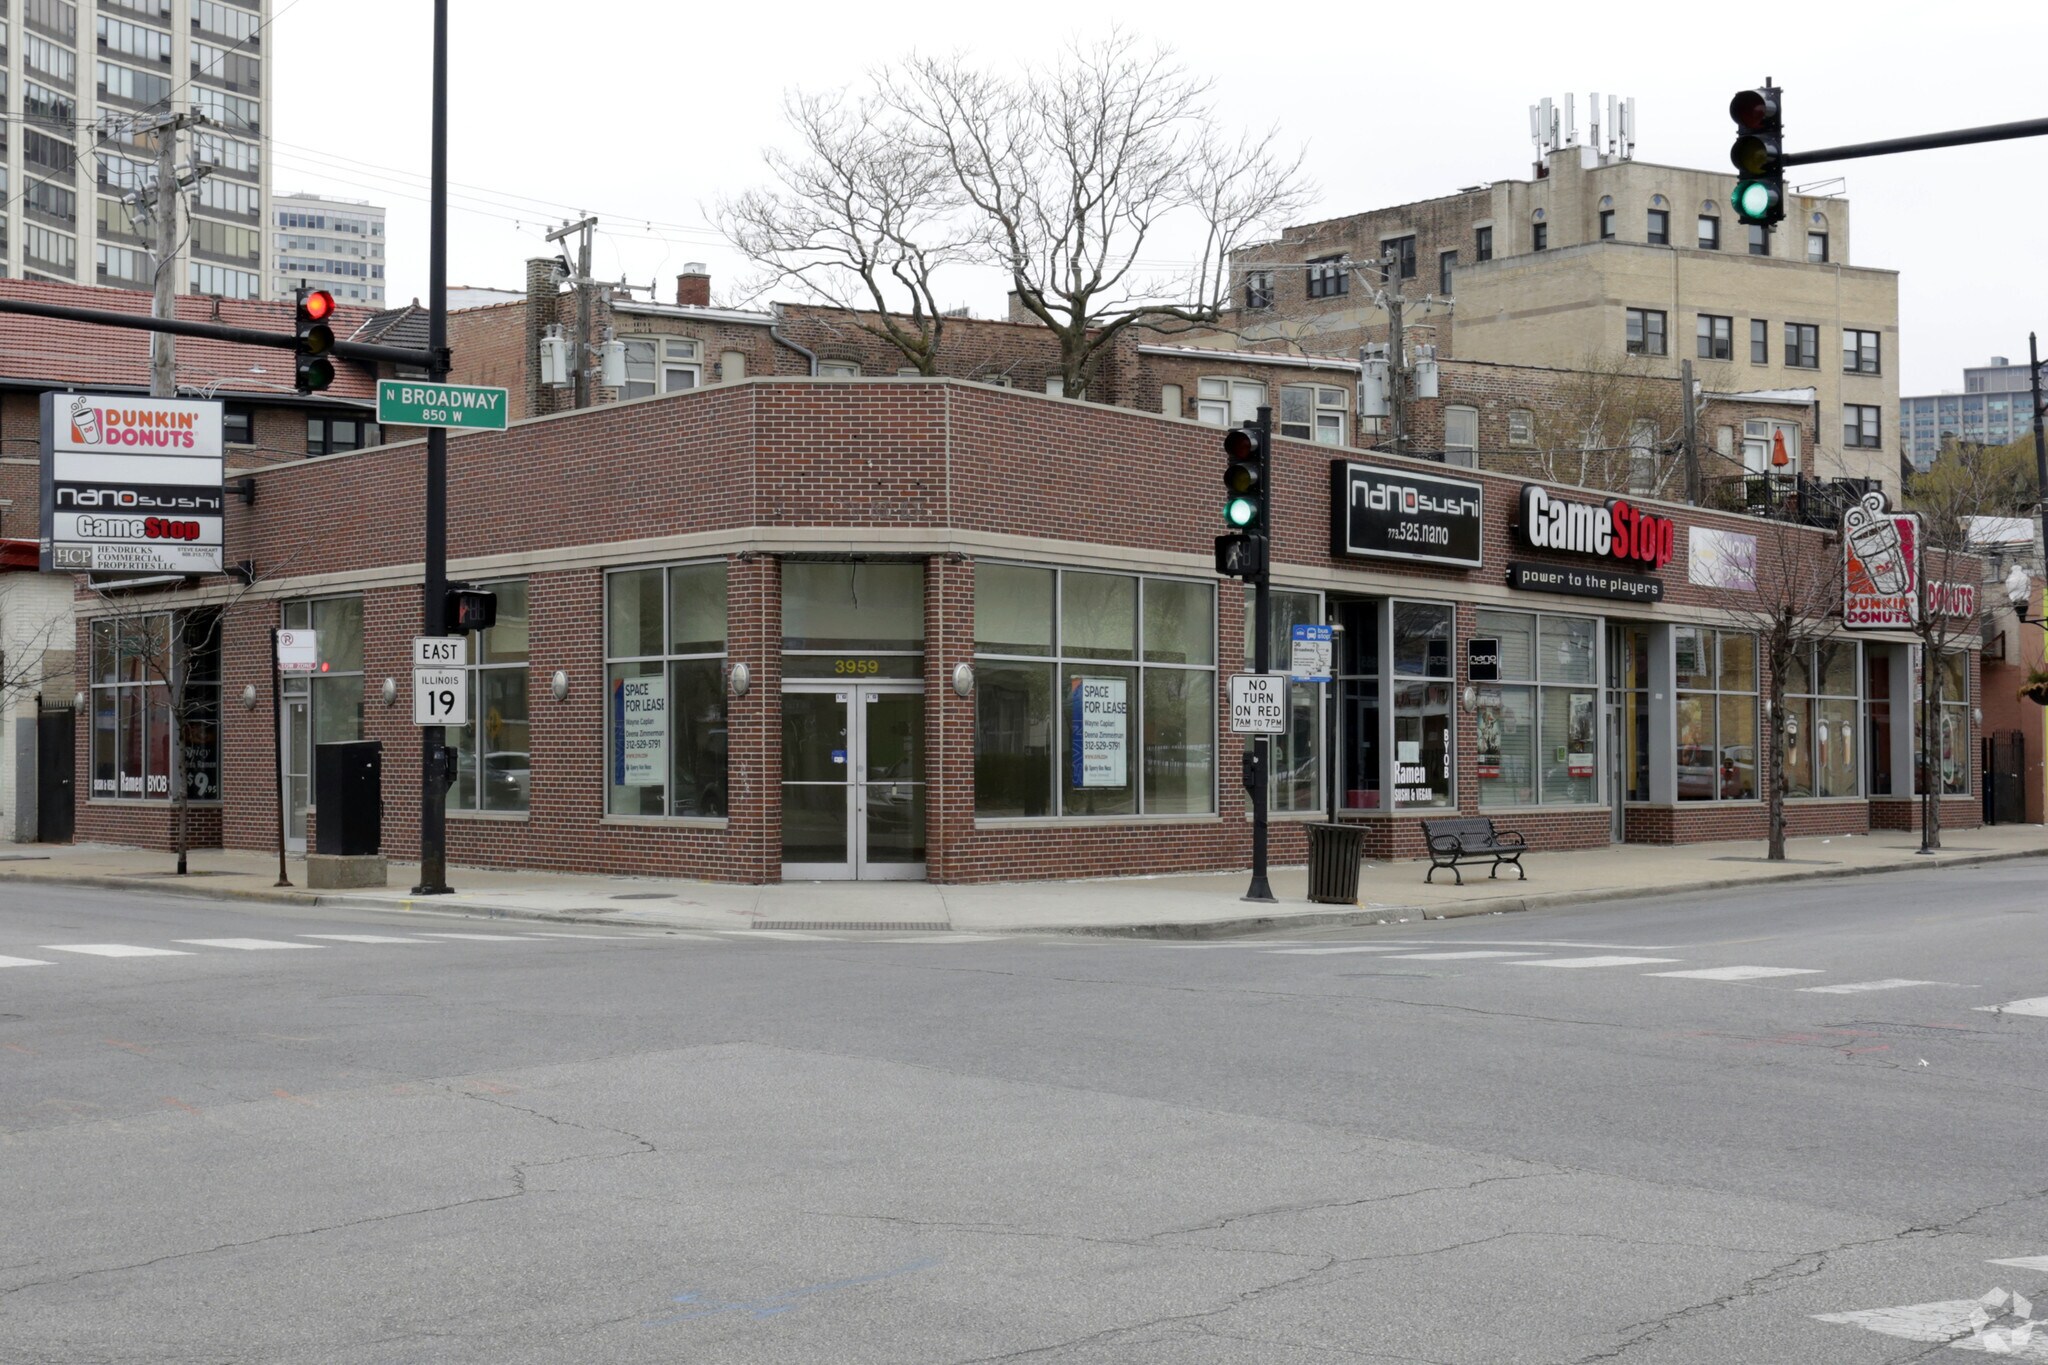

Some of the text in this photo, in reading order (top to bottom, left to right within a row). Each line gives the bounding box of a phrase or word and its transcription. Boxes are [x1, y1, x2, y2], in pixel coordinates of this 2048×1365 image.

[387, 388, 499, 410] N BROADWAY
[106, 409, 199, 429] DUNKIN'
[422, 409, 462, 422] 850 W
[106, 428, 194, 448] DONUTS
[77, 515, 200, 541] GameStop
[1529, 486, 1674, 569] GameStop
[98, 546, 153, 554] HENDRICKS
[57, 550, 92, 564] HCP
[97, 554, 164, 562] COMMERCIAL
[98, 562, 176, 570] PROPERTIES LLC
[1522, 570, 1658, 596] power to the players
[1847, 597, 1915, 610] DUNKIN'
[1847, 611, 1911, 623] DONUTS
[423, 644, 457, 659] EAST
[835, 660, 879, 673] 3959
[422, 676, 459, 684] ILLINOIS
[1249, 680, 1267, 691] NO
[625, 683, 649, 696] SPACE
[1084, 685, 1109, 698] SPACE
[428, 690, 455, 715] 19
[1243, 693, 1274, 703] TURN
[626, 700, 641, 712] FOR
[1085, 701, 1127, 714] FOR LEASE
[1235, 705, 1280, 717] ON RED
[1394, 761, 1426, 784] Ramen
[147, 775, 167, 792] BYOB
[1394, 788, 1432, 801] SUSHI & VEGAN
